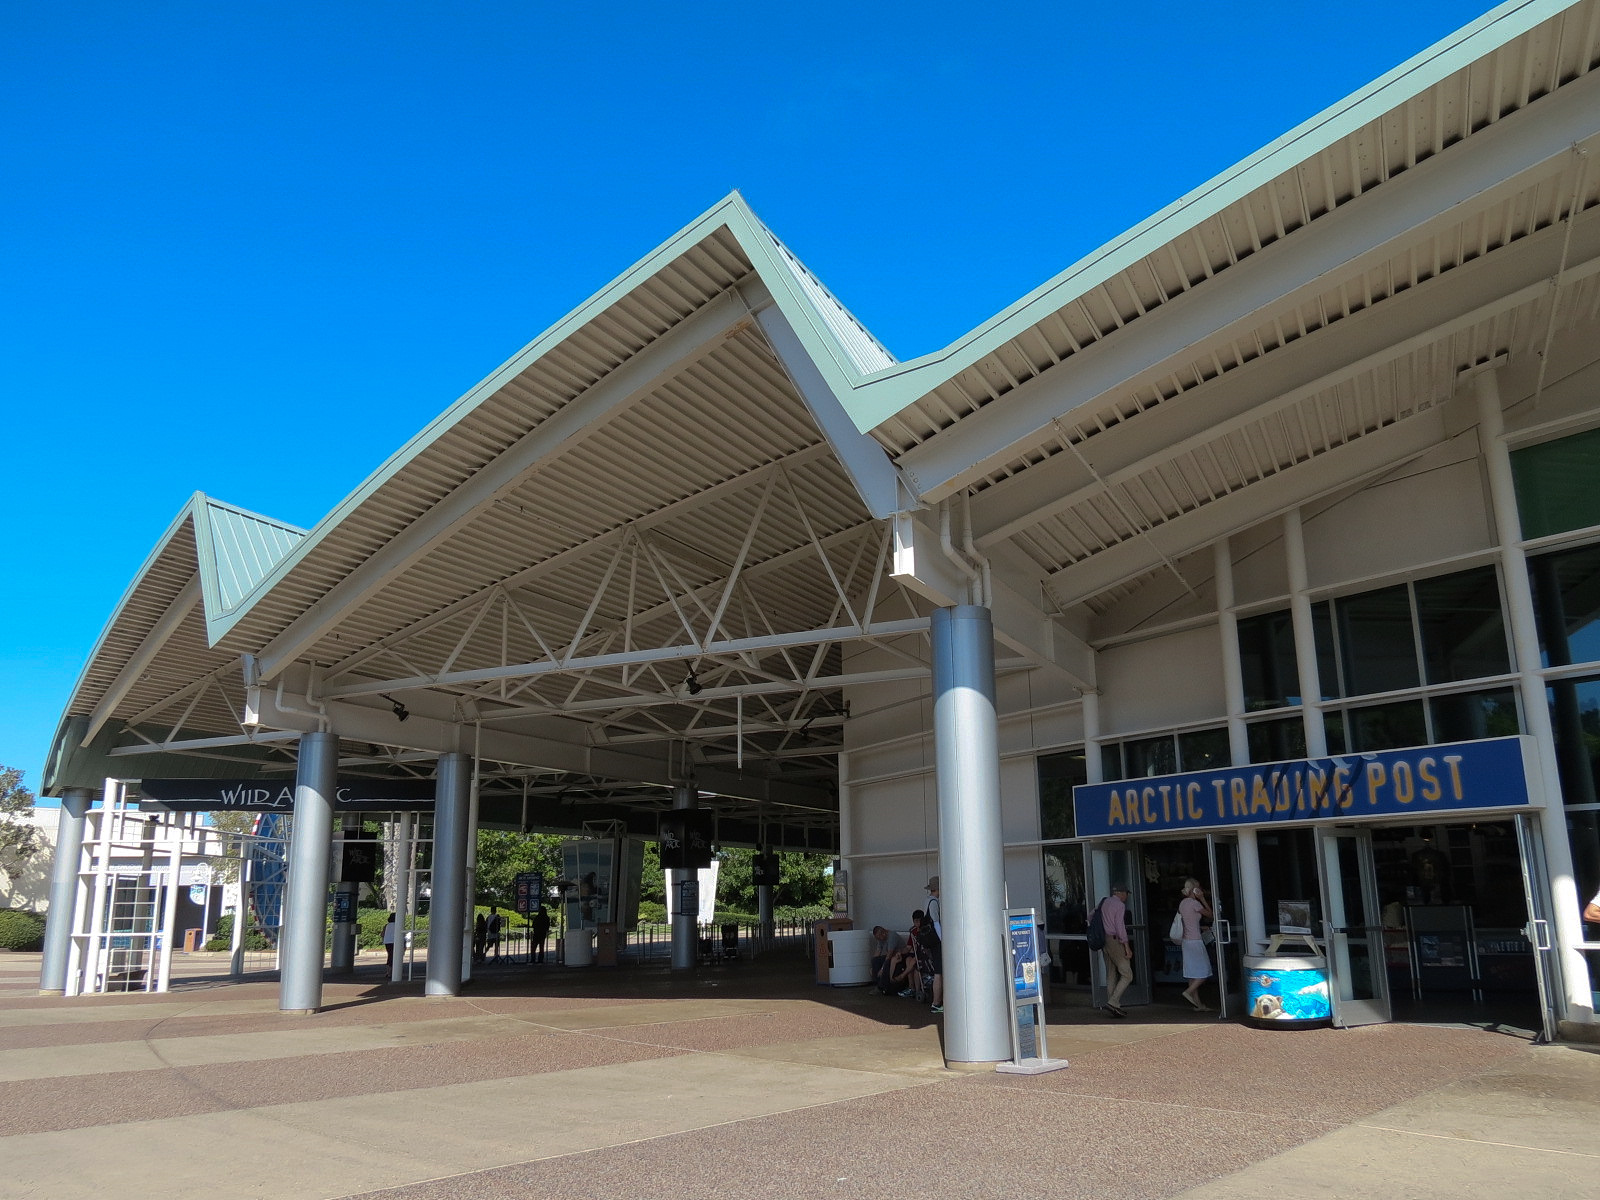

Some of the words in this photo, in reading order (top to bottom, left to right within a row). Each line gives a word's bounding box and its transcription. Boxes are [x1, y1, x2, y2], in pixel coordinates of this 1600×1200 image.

[220, 783, 271, 805] WILD
[1108, 781, 1204, 827] ARCTIC
[1211, 766, 1353, 819] TRADING
[1365, 755, 1463, 805] POST
